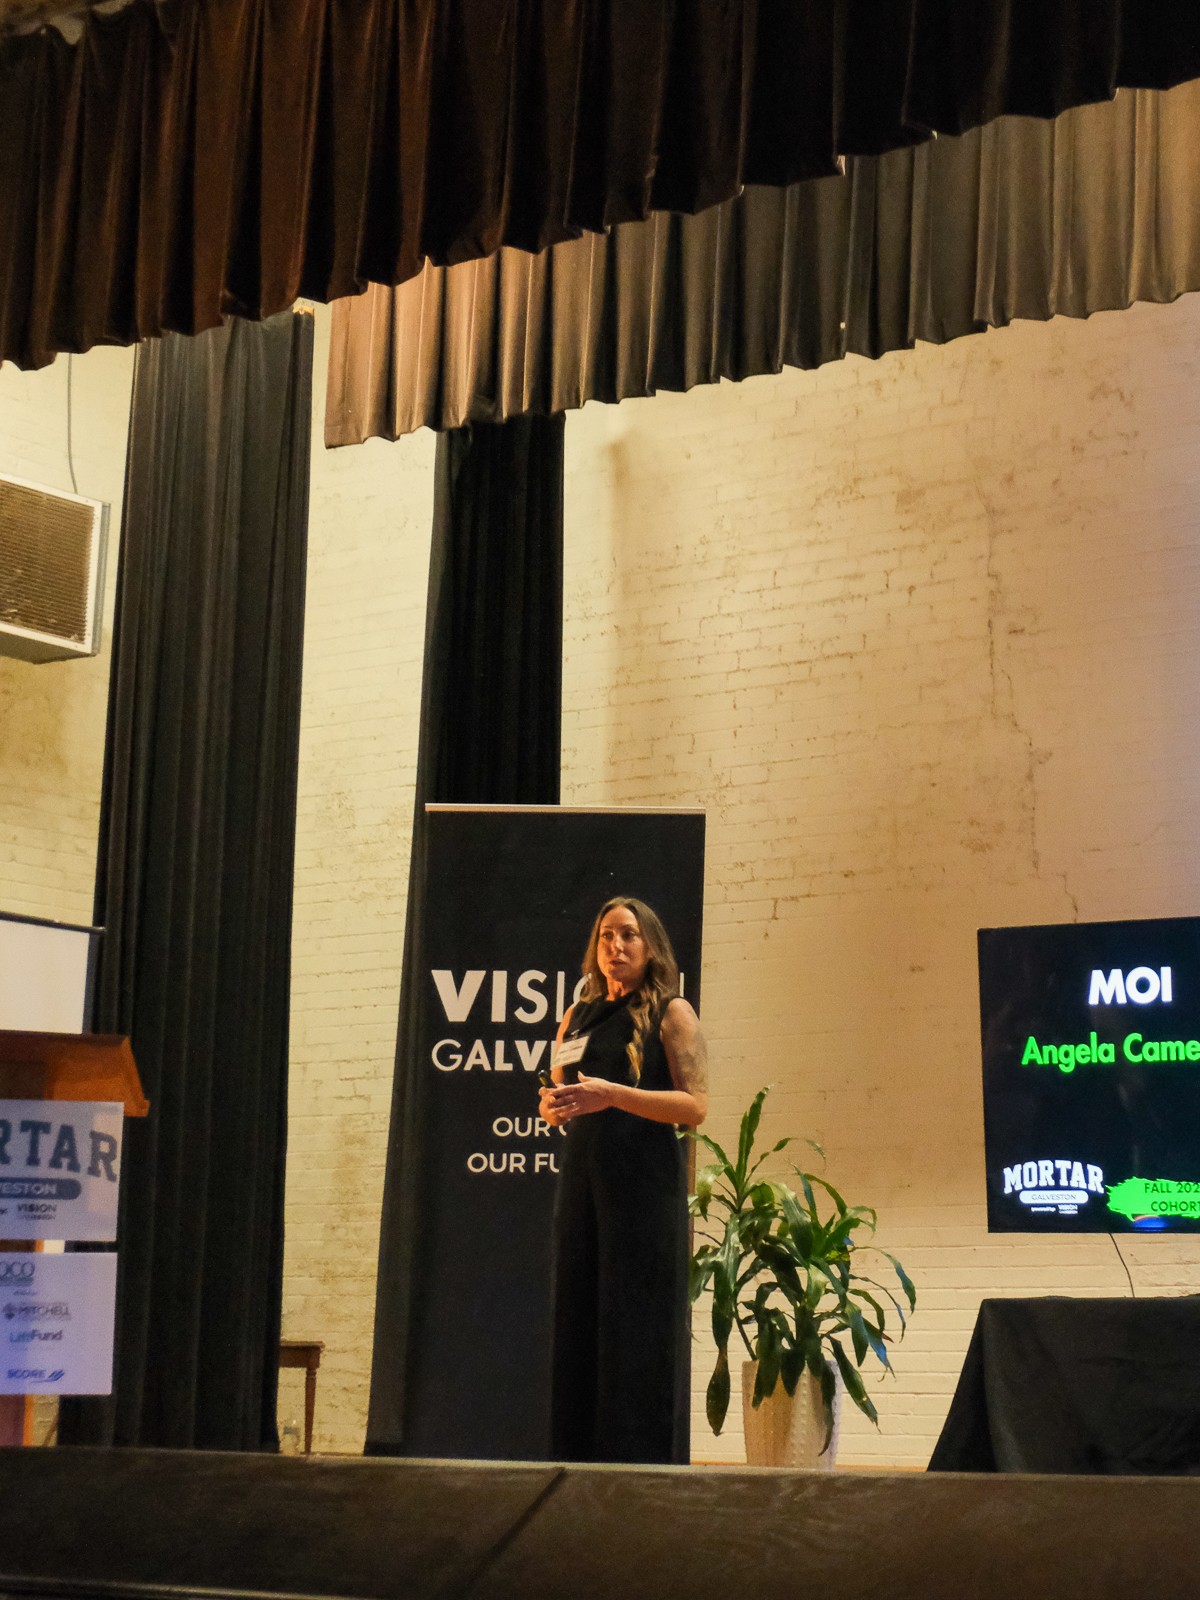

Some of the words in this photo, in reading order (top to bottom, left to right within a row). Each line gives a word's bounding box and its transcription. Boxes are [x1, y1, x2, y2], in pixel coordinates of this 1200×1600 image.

[431, 969, 685, 1024] VISI
[1088, 966, 1172, 1005] MOI
[431, 1039, 553, 1072] GALV
[1021, 1032, 1116, 1073] Angela
[492, 1117, 550, 1137] OUR
[467, 1153, 526, 1173] OUR
[0, 1182, 58, 1195] ESTON
[1003, 1160, 1105, 1194] MORTAR
[1144, 1183, 1172, 1194] FALL
[7, 1369, 46, 1379] SCORE
